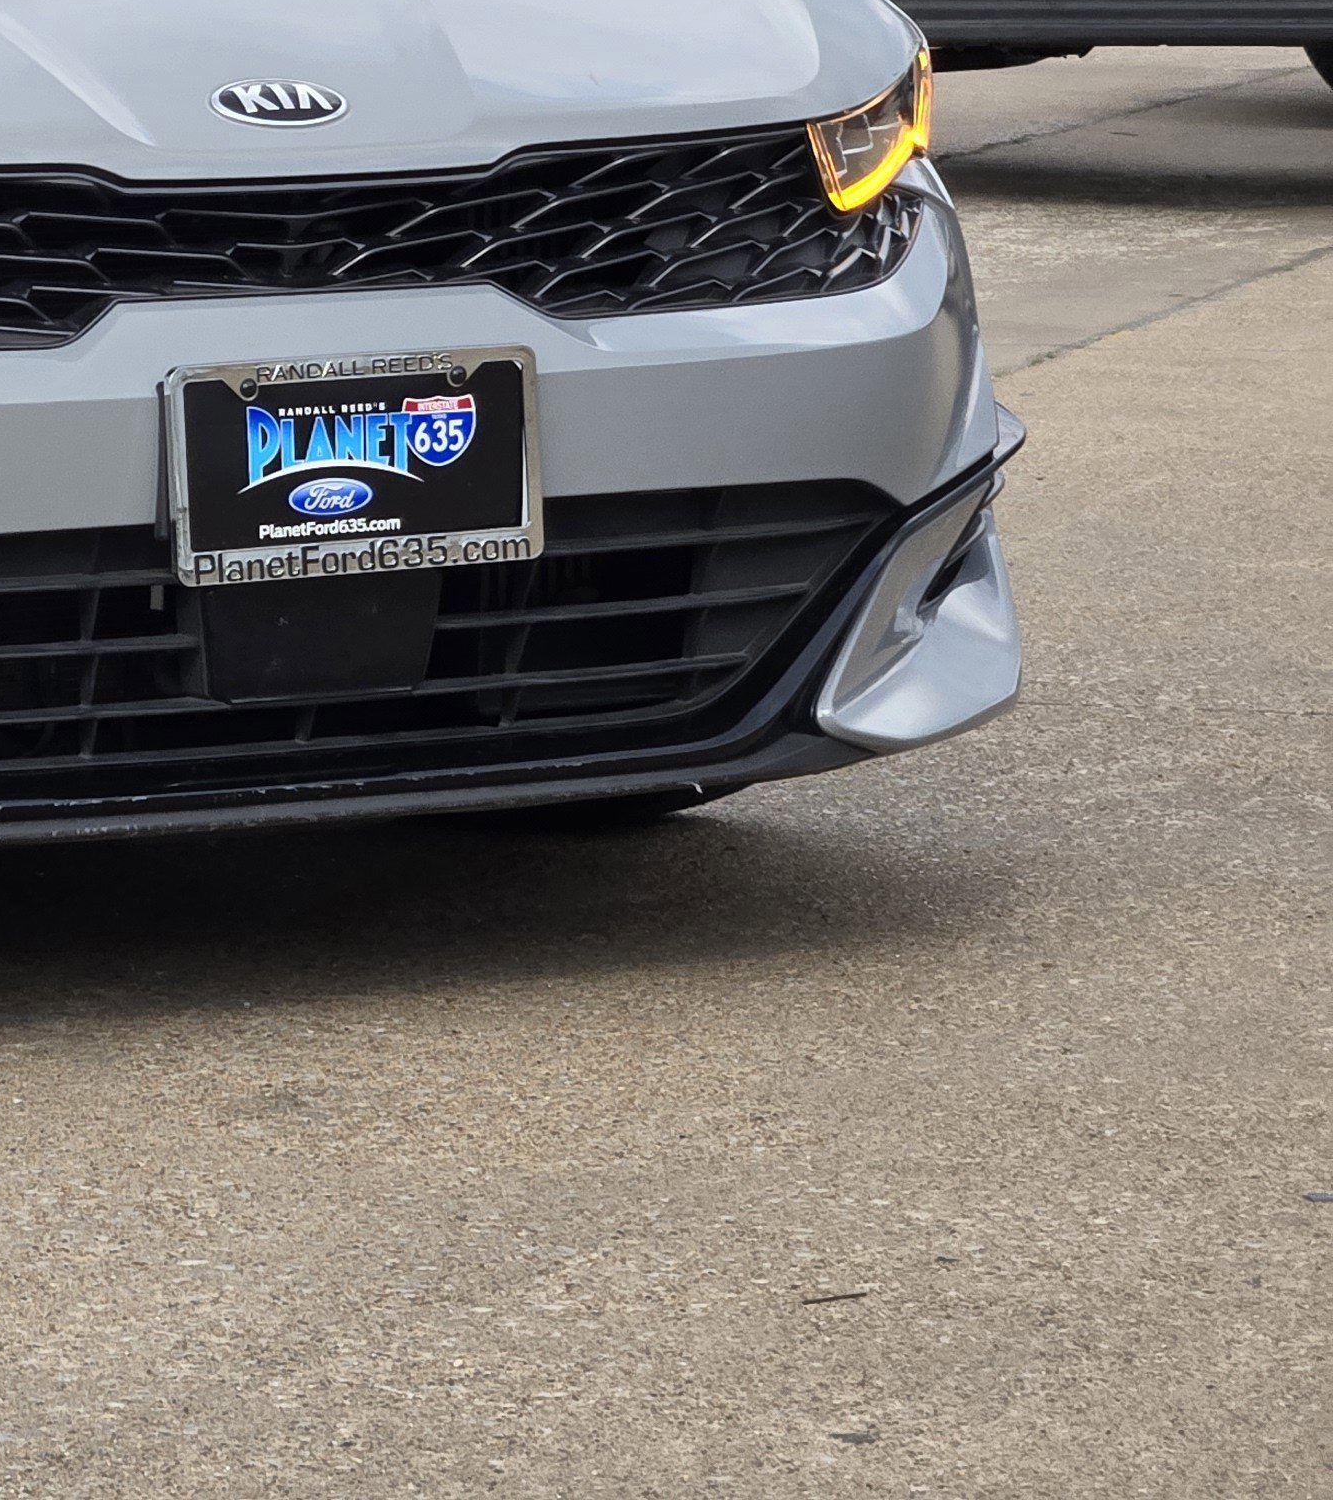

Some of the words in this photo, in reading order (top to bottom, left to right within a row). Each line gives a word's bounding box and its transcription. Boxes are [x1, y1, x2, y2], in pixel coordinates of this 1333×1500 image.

[228, 83, 334, 114] KIA
[255, 360, 366, 384] RANDALL
[371, 352, 454, 375] REED'S
[277, 405, 336, 418] RANDALL
[340, 401, 387, 414] REED'S
[245, 405, 412, 485] PLANET
[414, 419, 465, 454] 635
[303, 483, 356, 511] Ford
[258, 516, 402, 541] PlanetFord635.com
[192, 534, 533, 585] PlanetFord635.com
